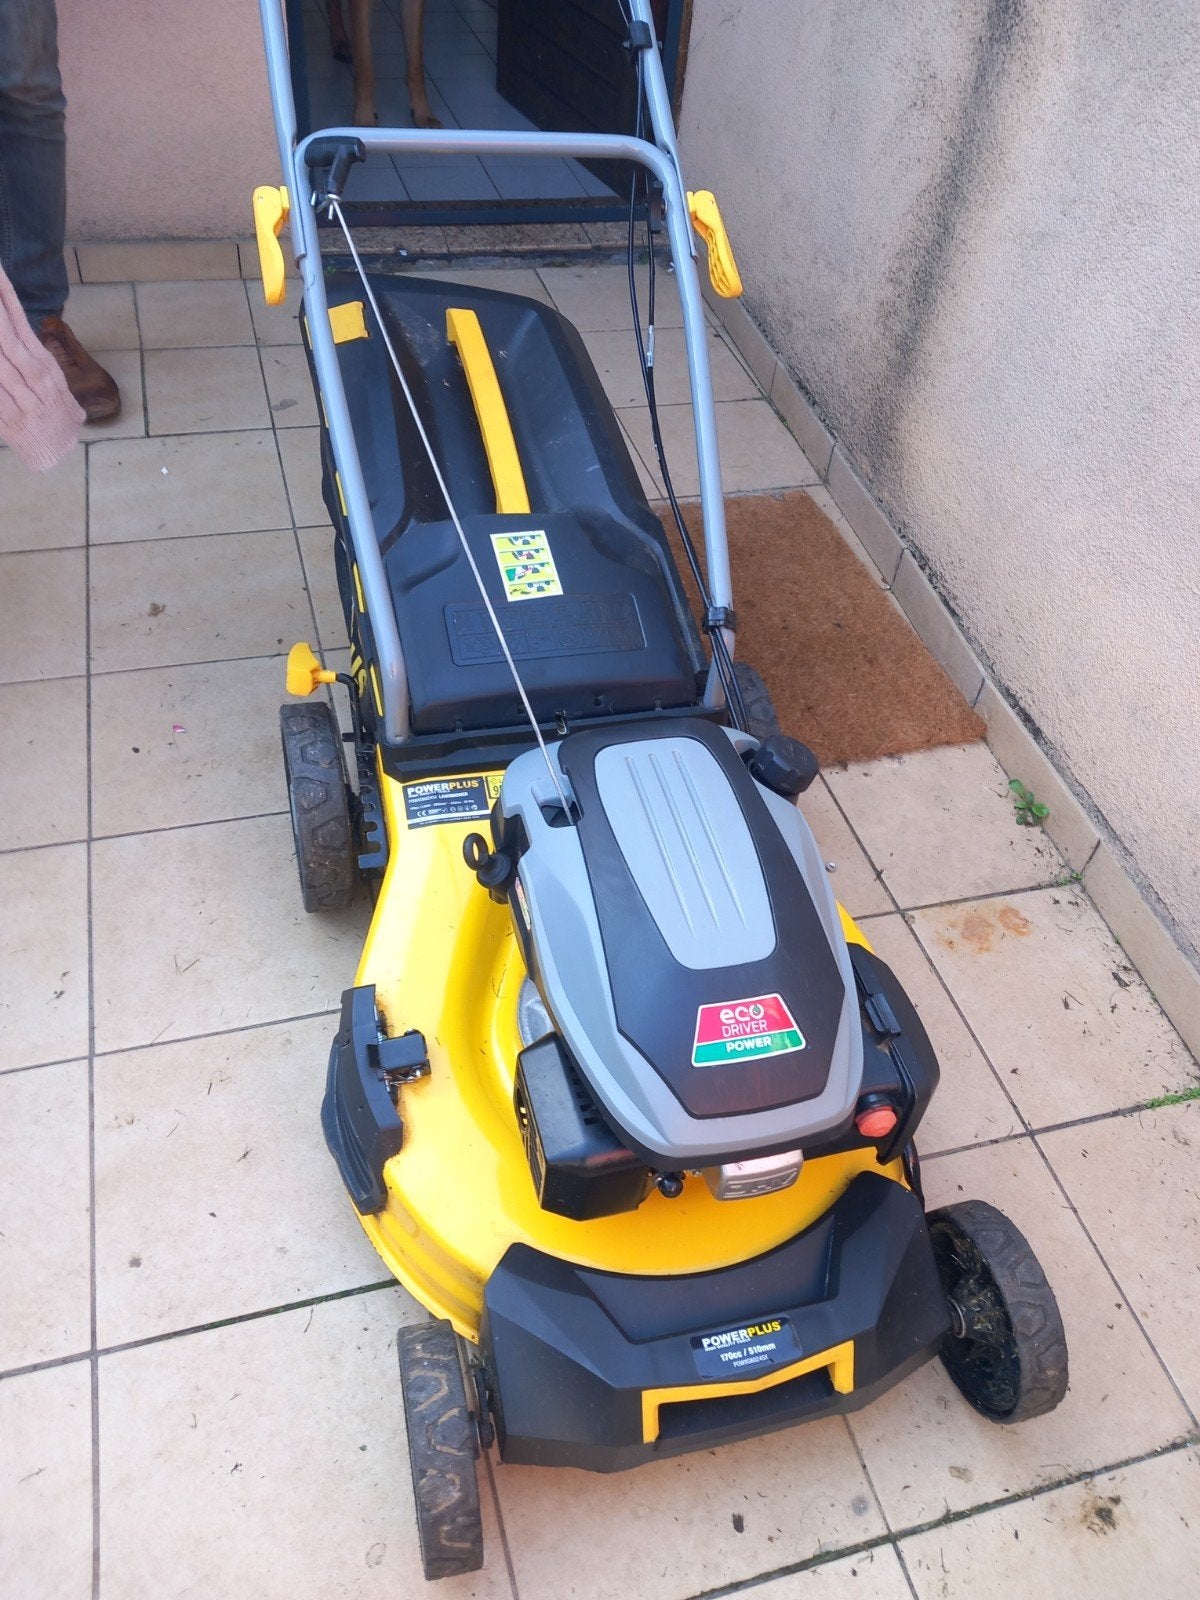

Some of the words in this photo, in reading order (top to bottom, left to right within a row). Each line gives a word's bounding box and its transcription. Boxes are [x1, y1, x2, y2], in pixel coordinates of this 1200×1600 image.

[407, 780, 479, 795] POWERPLUS
[720, 1004, 765, 1024] eco
[722, 1020, 768, 1037] DRIVER
[726, 1036, 772, 1052] POWER
[702, 1321, 781, 1348] POWERPLUS
[720, 1351, 743, 1362] 170cc
[748, 1343, 777, 1355] 510mm
